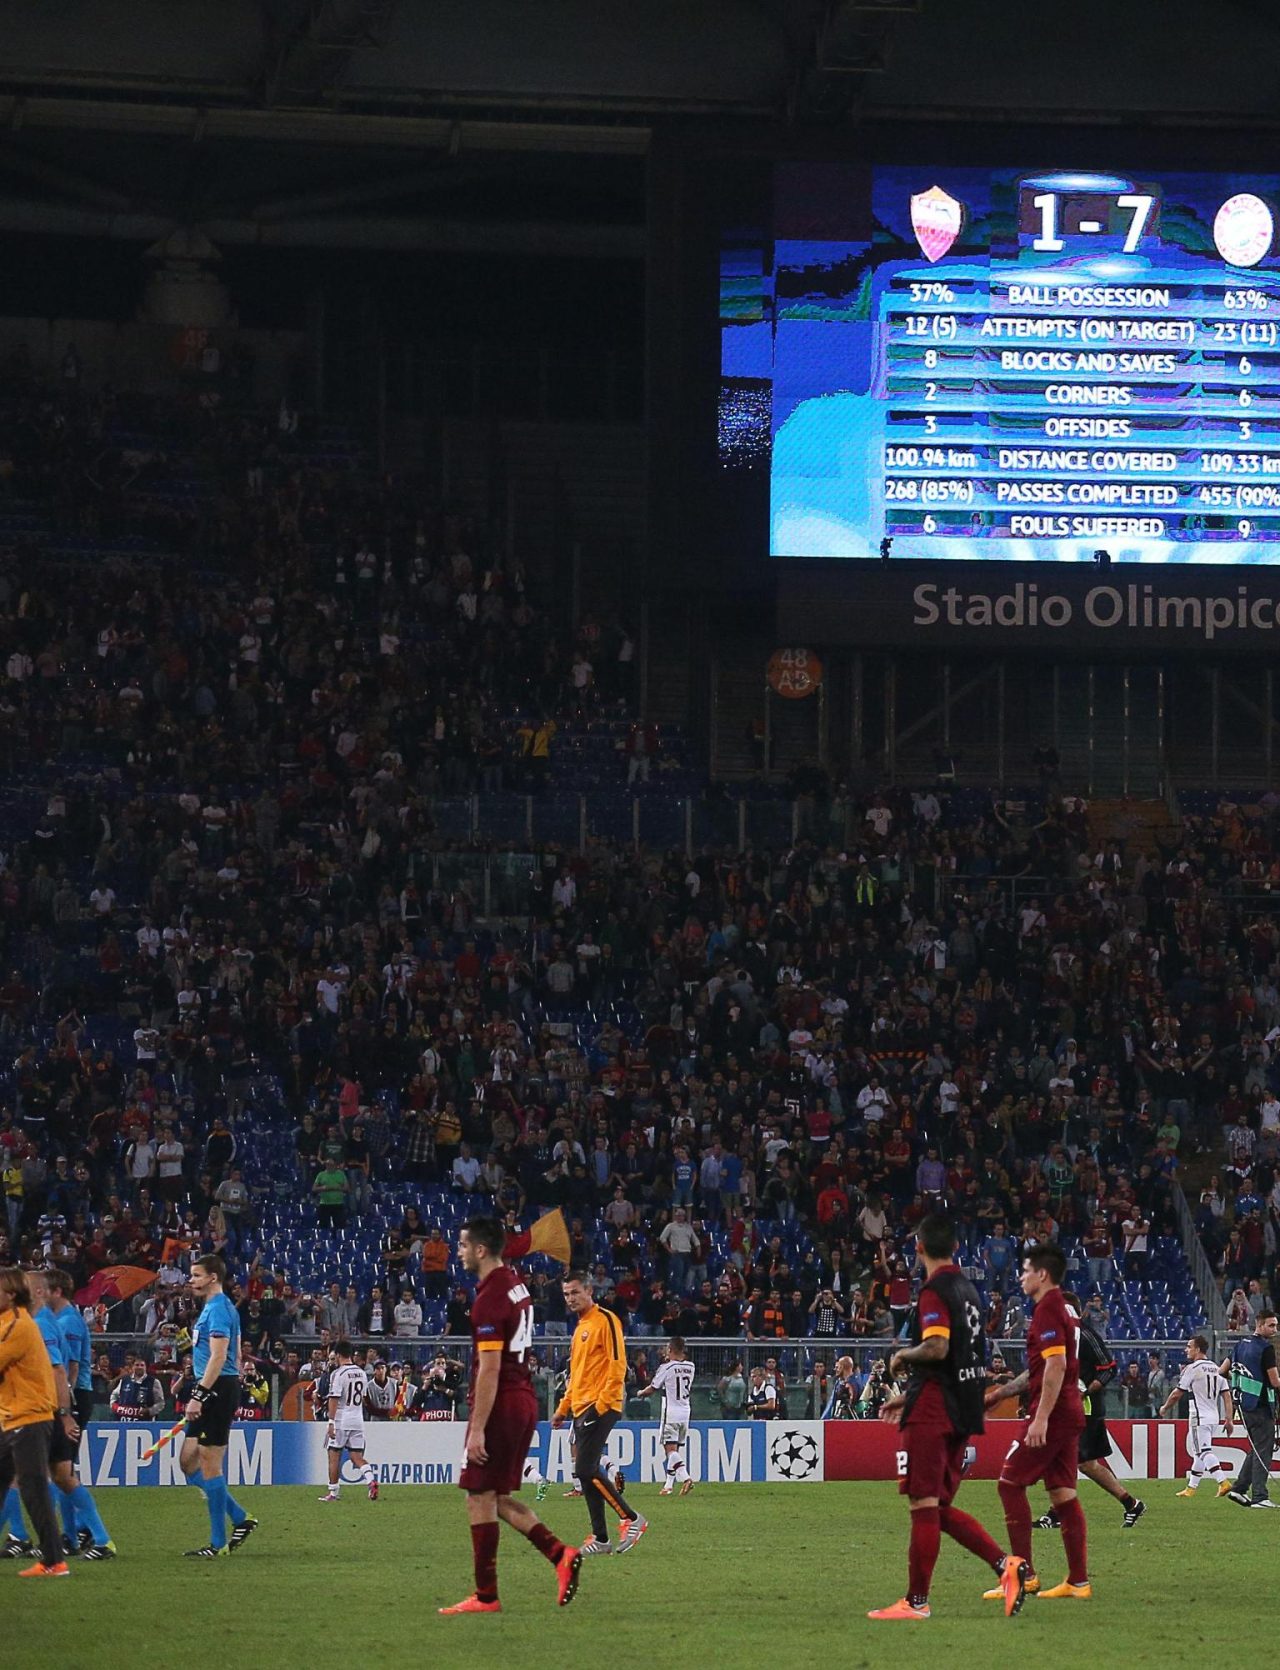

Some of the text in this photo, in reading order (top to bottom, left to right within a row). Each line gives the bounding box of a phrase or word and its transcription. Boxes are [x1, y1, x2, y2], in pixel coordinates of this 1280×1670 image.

[1033, 193, 1064, 251] 1
[1079, 221, 1102, 232] -
[1117, 195, 1152, 252] 7
[909, 283, 1267, 310] 37% BALL POSSESSION 63%
[905, 315, 1277, 345] 12 (5) ATTEMPTS (ON TARGET) 23 (11)
[924, 350, 1251, 375] 8 BLOCKS AND SAVES 6
[924, 383, 1251, 407] 2 CORNERS 6
[924, 416, 1250, 440] 3 OFFSIDES 3
[885, 448, 945, 467] 100.94
[948, 448, 976, 468] km
[999, 451, 1087, 471] DISTANCE
[1090, 453, 1177, 472] COVERED
[1201, 453, 1261, 473] 109.33
[885, 481, 917, 500] 268
[920, 480, 974, 504] (85%)
[997, 482, 1063, 502] PASSES
[1066, 483, 1178, 504] COMPLETED
[1200, 486, 1232, 505] 455
[923, 515, 1250, 538] 6 FOULS SUFFERED 9
[912, 583, 1073, 628] Stadio
[781, 648, 808, 669] 48
[346, 1381, 363, 1407] 18
[675, 1376, 691, 1402] 13
[1004, 1439, 1020, 1461] 7
[369, 1463, 453, 1484] GAZPROM
